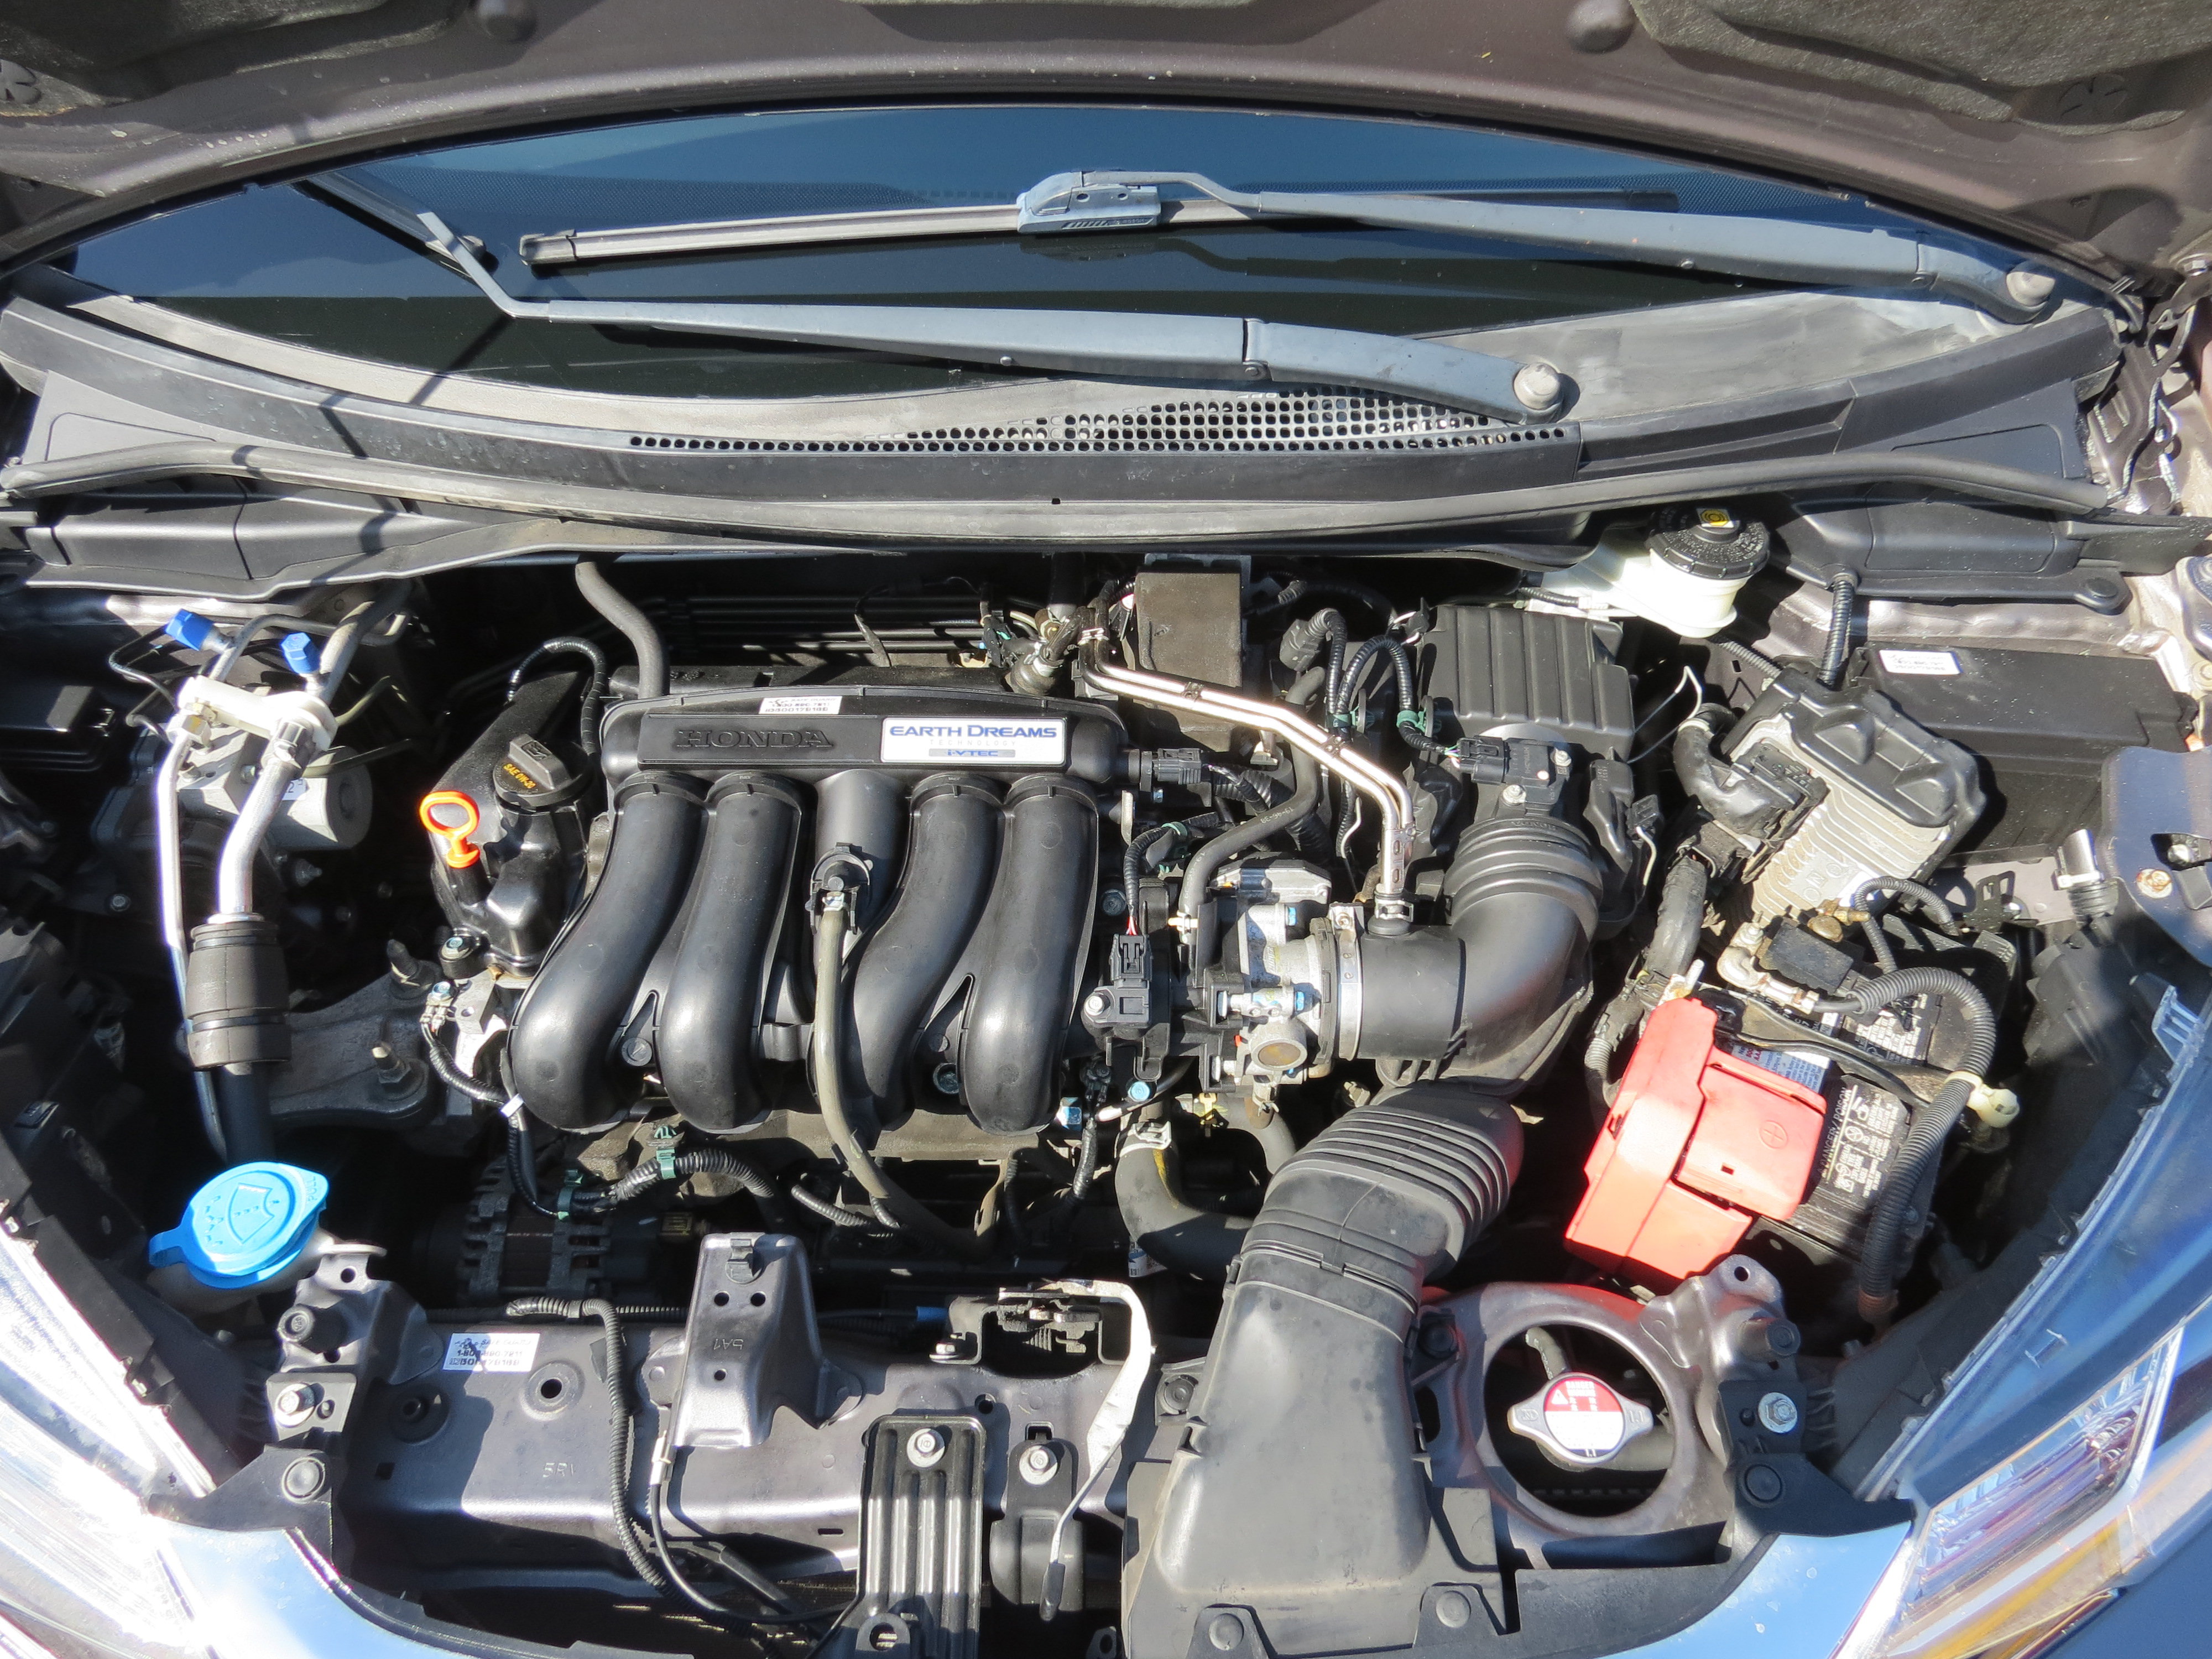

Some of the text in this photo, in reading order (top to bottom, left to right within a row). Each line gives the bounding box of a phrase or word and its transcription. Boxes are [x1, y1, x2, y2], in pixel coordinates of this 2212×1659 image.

[675, 729, 834, 748] HONDA
[890, 724, 1057, 738] EARTH DREAMS
[503, 763, 520, 775] SAE
[515, 773, 536, 789] 0W-20
[1833, 1086, 1852, 1121] POISON
